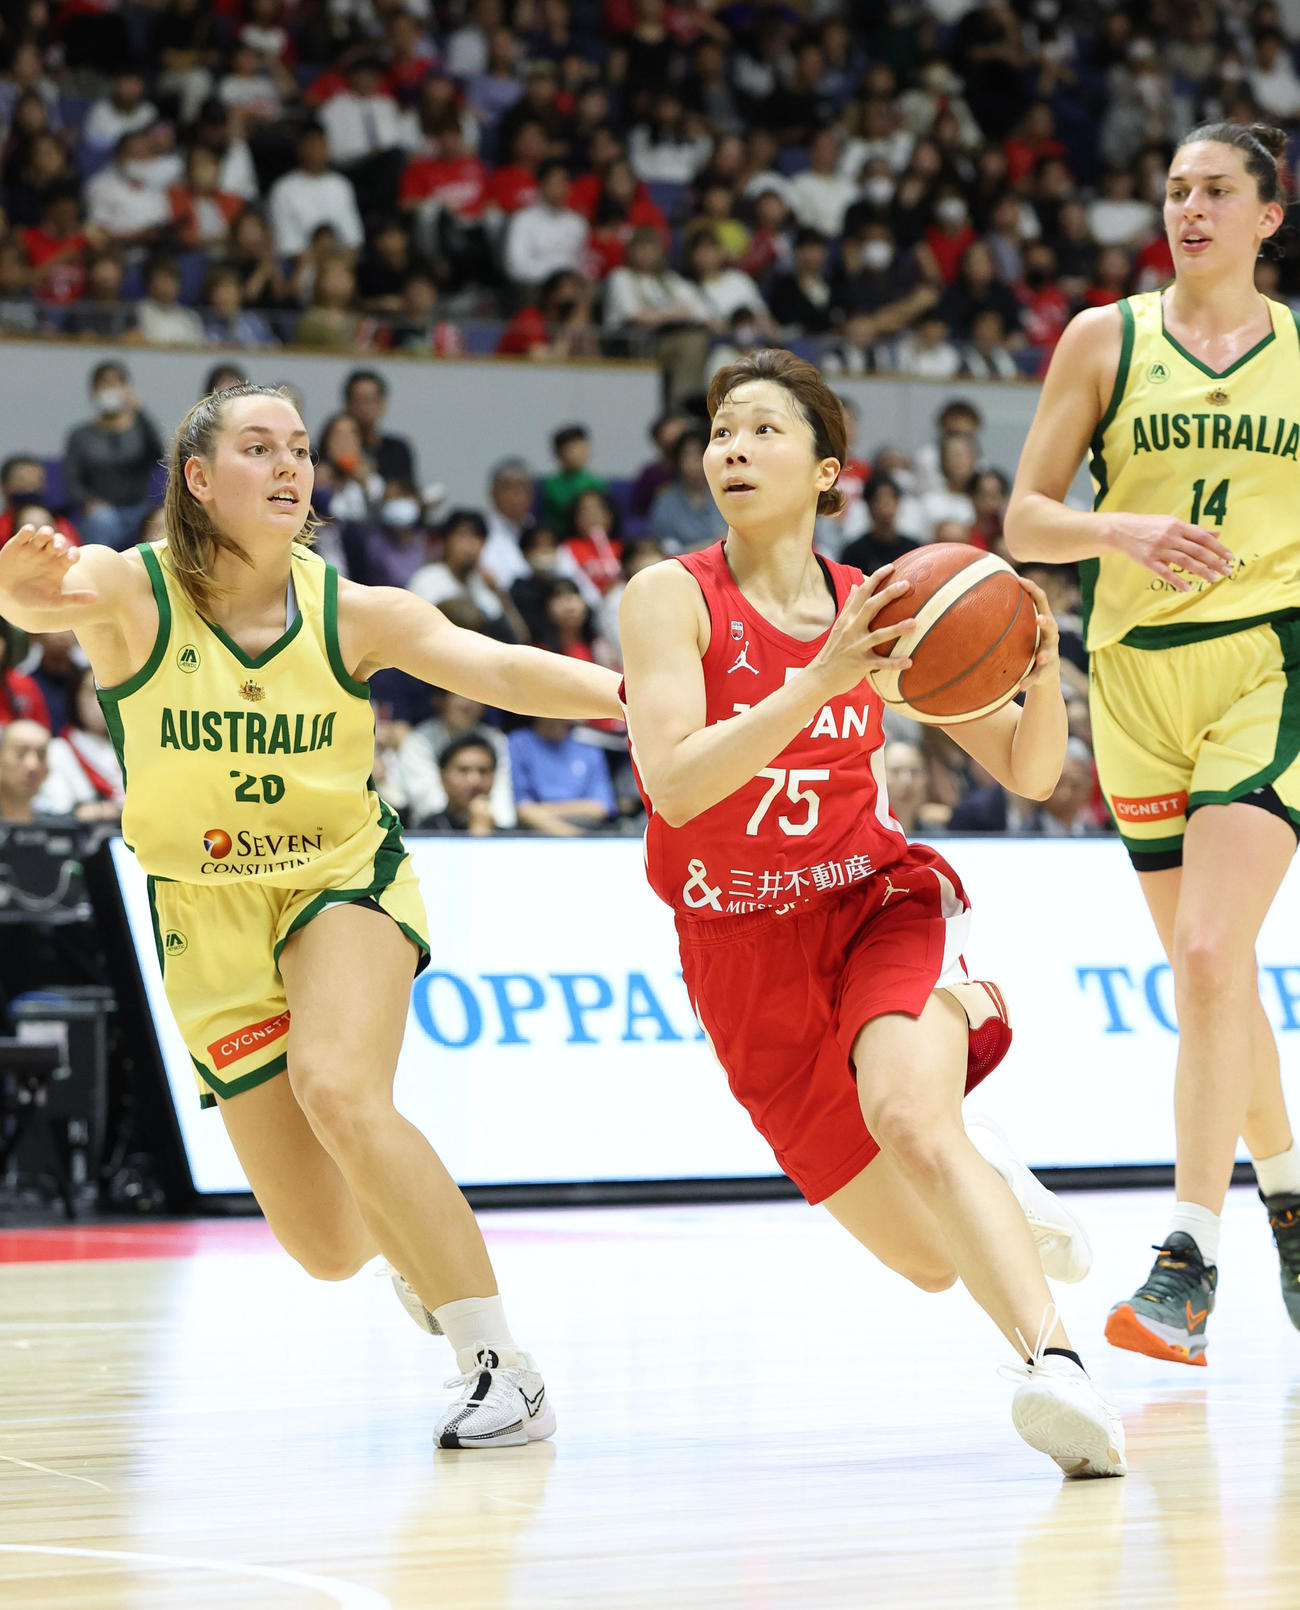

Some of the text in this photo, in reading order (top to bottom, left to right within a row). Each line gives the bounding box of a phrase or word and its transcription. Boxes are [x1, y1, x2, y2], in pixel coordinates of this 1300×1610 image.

[1133, 413, 1300, 461] AUSTRALIA
[1190, 479, 1230, 526] 14
[160, 707, 337, 755] AUSTRALIA
[229, 770, 286, 805] 20
[745, 767, 831, 837] 75
[1116, 798, 1179, 816] CYGNETT
[237, 830, 323, 857] SEVEN
[683, 854, 877, 912] & 三井不動産
[413, 969, 708, 1050] OPPA
[220, 1012, 291, 1057] CYGNETT
